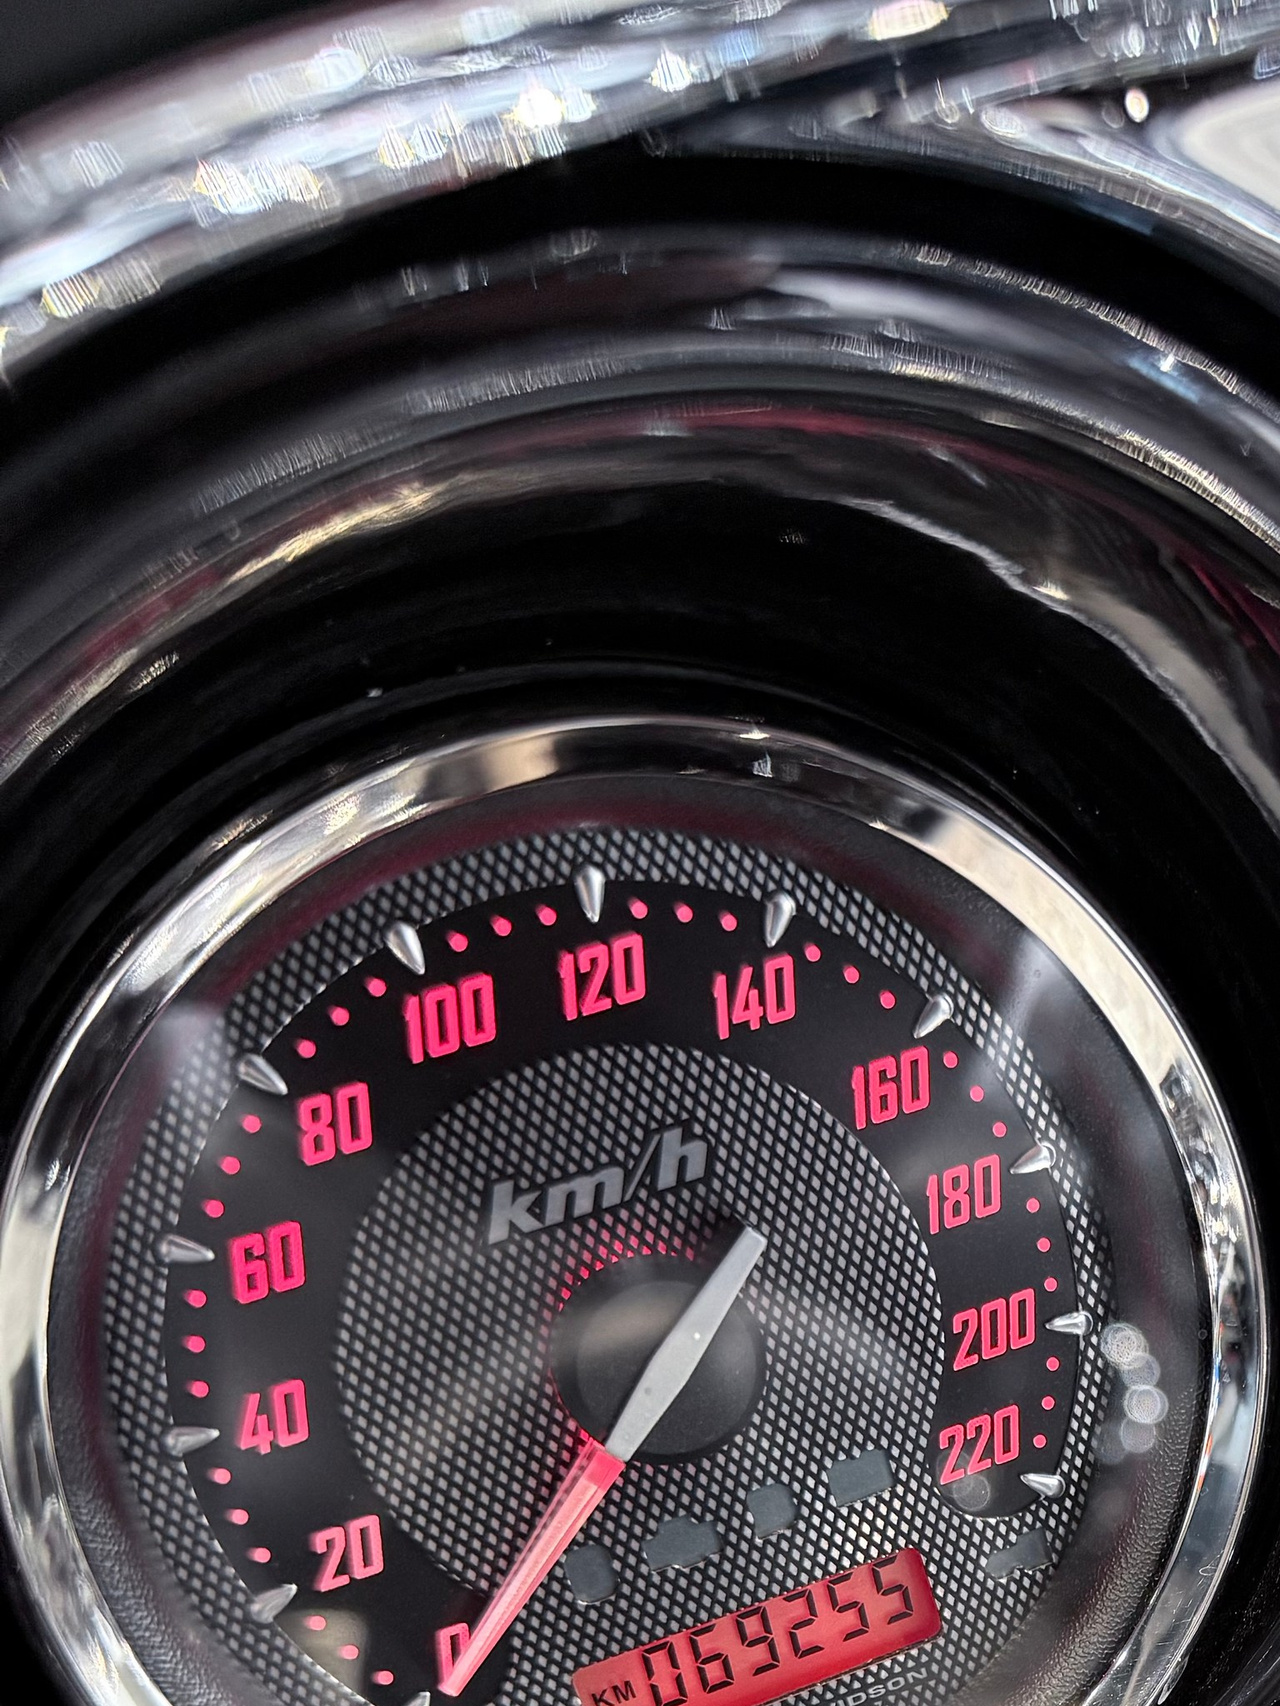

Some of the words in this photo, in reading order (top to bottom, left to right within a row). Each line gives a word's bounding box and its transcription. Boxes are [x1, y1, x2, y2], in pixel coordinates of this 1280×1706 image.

[403, 972, 496, 1064] 100
[560, 932, 647, 1021] 120
[714, 954, 796, 1040] 140
[298, 1081, 372, 1166] 80
[851, 1045, 930, 1130] 160
[488, 1127, 707, 1243] km/h
[926, 1154, 1003, 1235] 180
[229, 1220, 305, 1304] 60
[952, 1288, 1037, 1371] 200
[237, 1379, 311, 1455] 40
[939, 1404, 1021, 1486] 220
[309, 1514, 384, 1593] 20
[434, 1622, 471, 1694] 0
